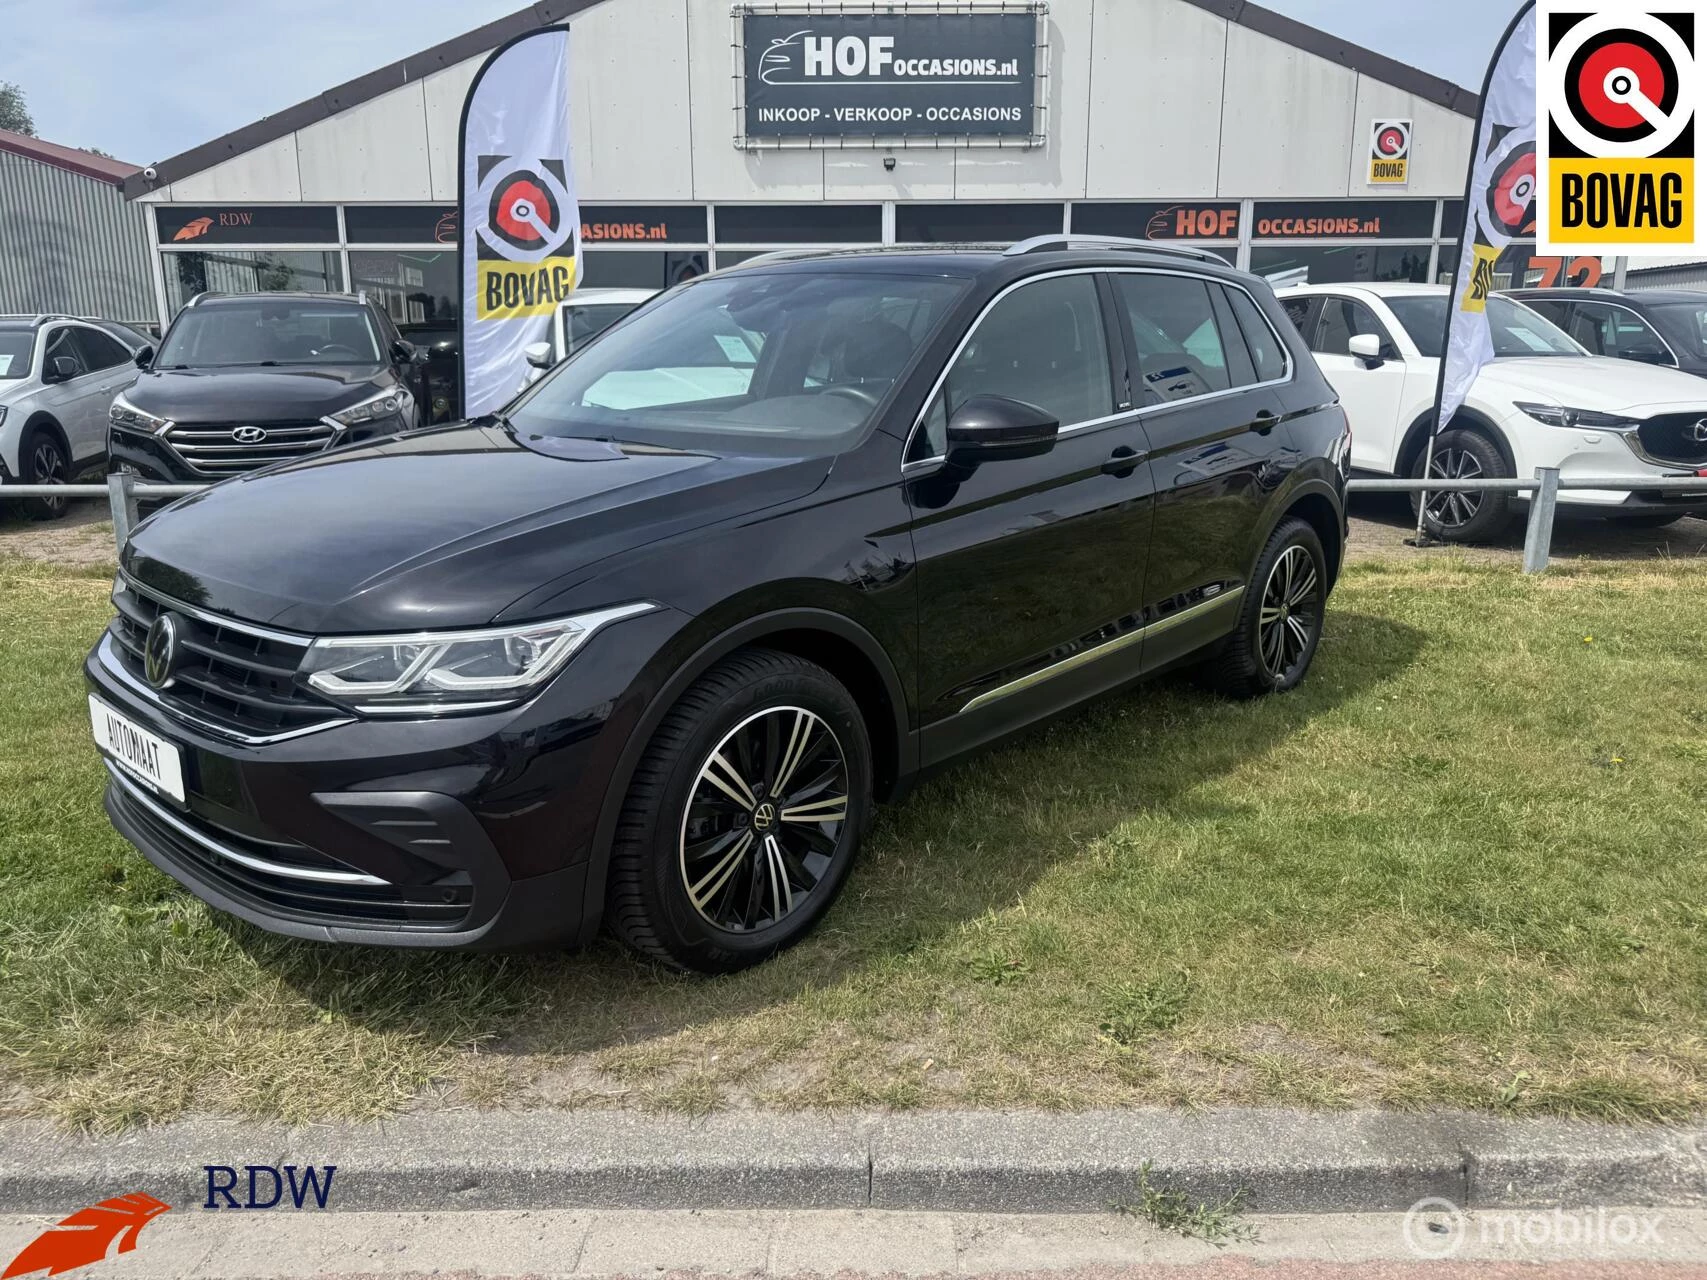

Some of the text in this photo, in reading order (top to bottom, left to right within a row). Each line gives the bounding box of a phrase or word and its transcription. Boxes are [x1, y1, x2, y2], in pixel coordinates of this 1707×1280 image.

[758, 107, 821, 122] INKOOP
[833, 107, 913, 122] VERKOOP
[925, 107, 1022, 121] OCCASIONS
[1373, 162, 1404, 178] BOVAG
[219, 212, 253, 226] RDW
[1175, 210, 1238, 236] HOF
[1257, 217, 1381, 236] OCCASIONS.nl
[485, 265, 569, 311] BOVAG
[106, 713, 161, 780] AUTOMAAT
